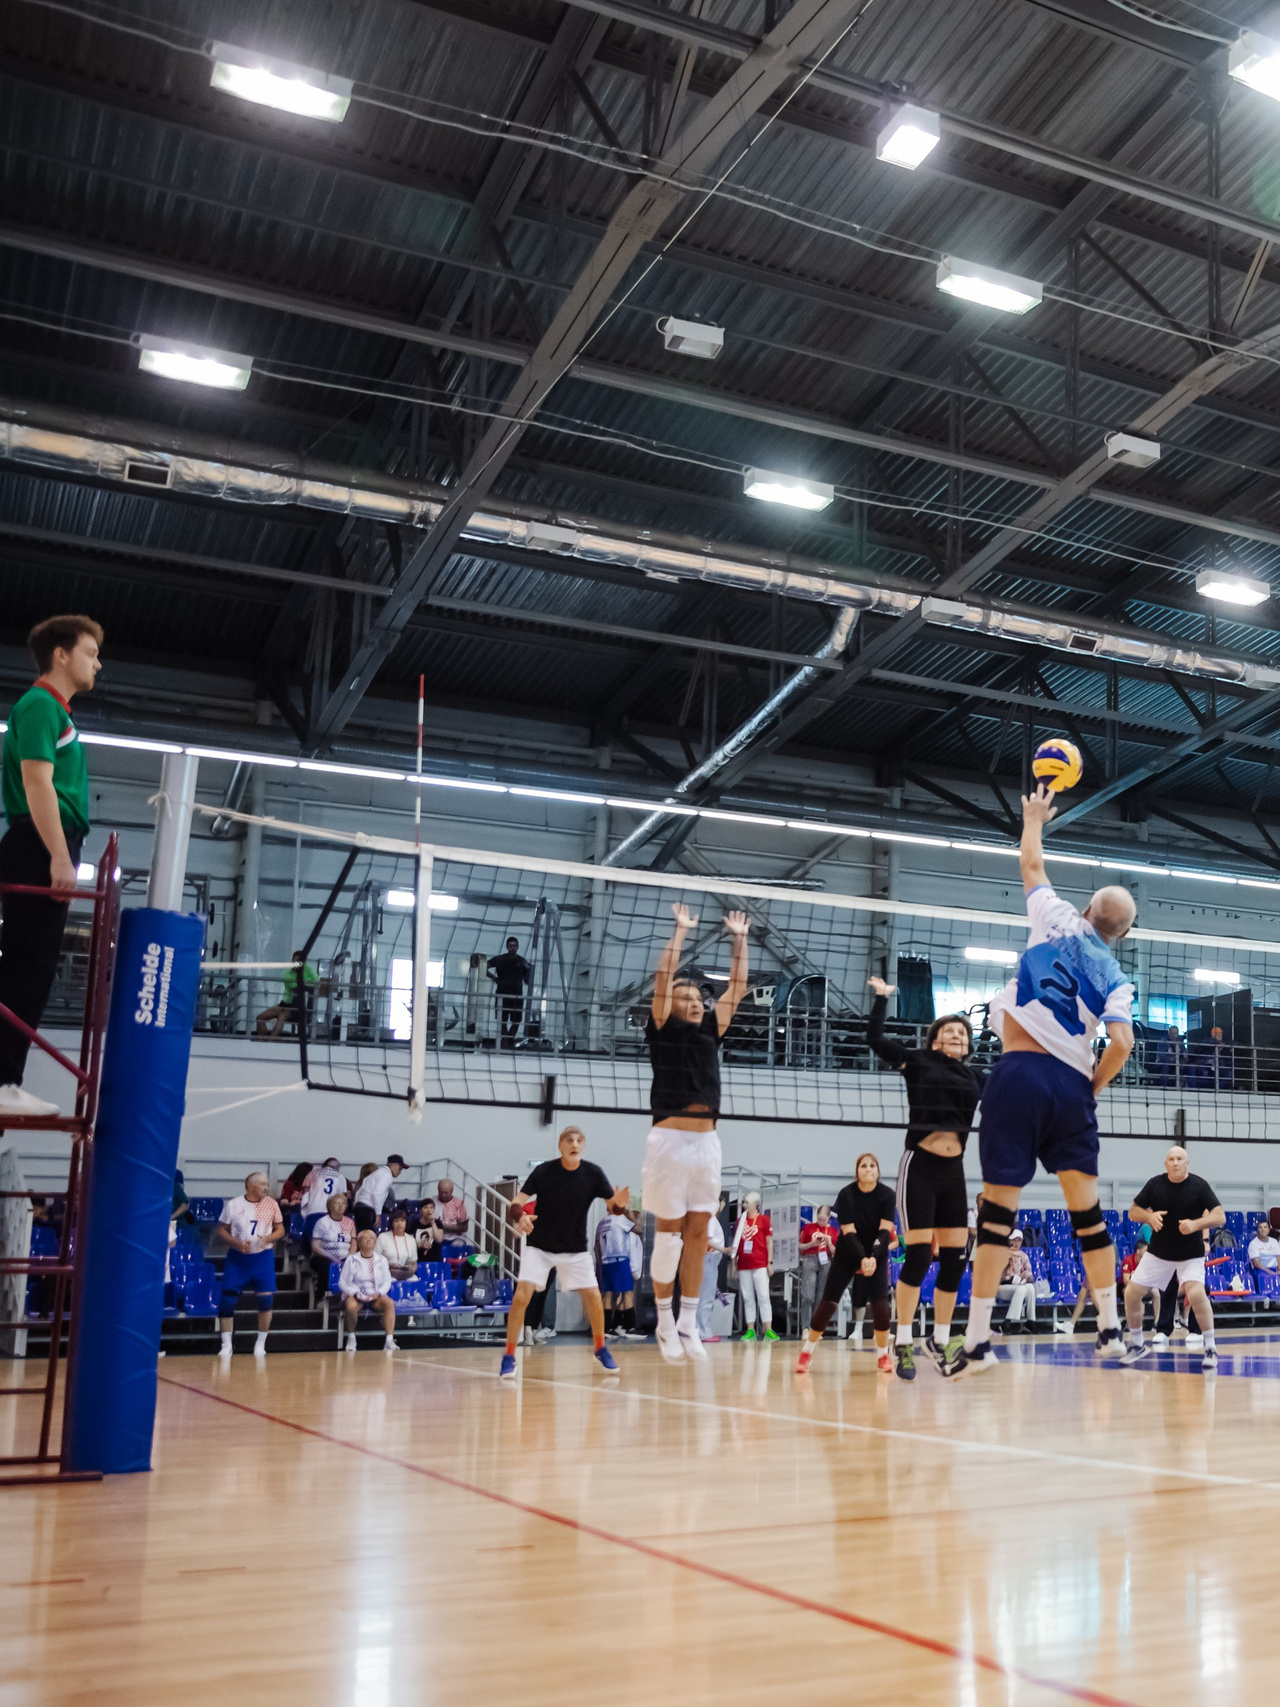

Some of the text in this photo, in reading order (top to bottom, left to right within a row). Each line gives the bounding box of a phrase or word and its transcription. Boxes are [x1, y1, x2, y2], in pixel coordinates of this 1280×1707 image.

[135, 942, 161, 1025] Schelde
[154, 946, 175, 1028] International
[323, 1178, 334, 1195] 3
[249, 1220, 258, 1235] 7
